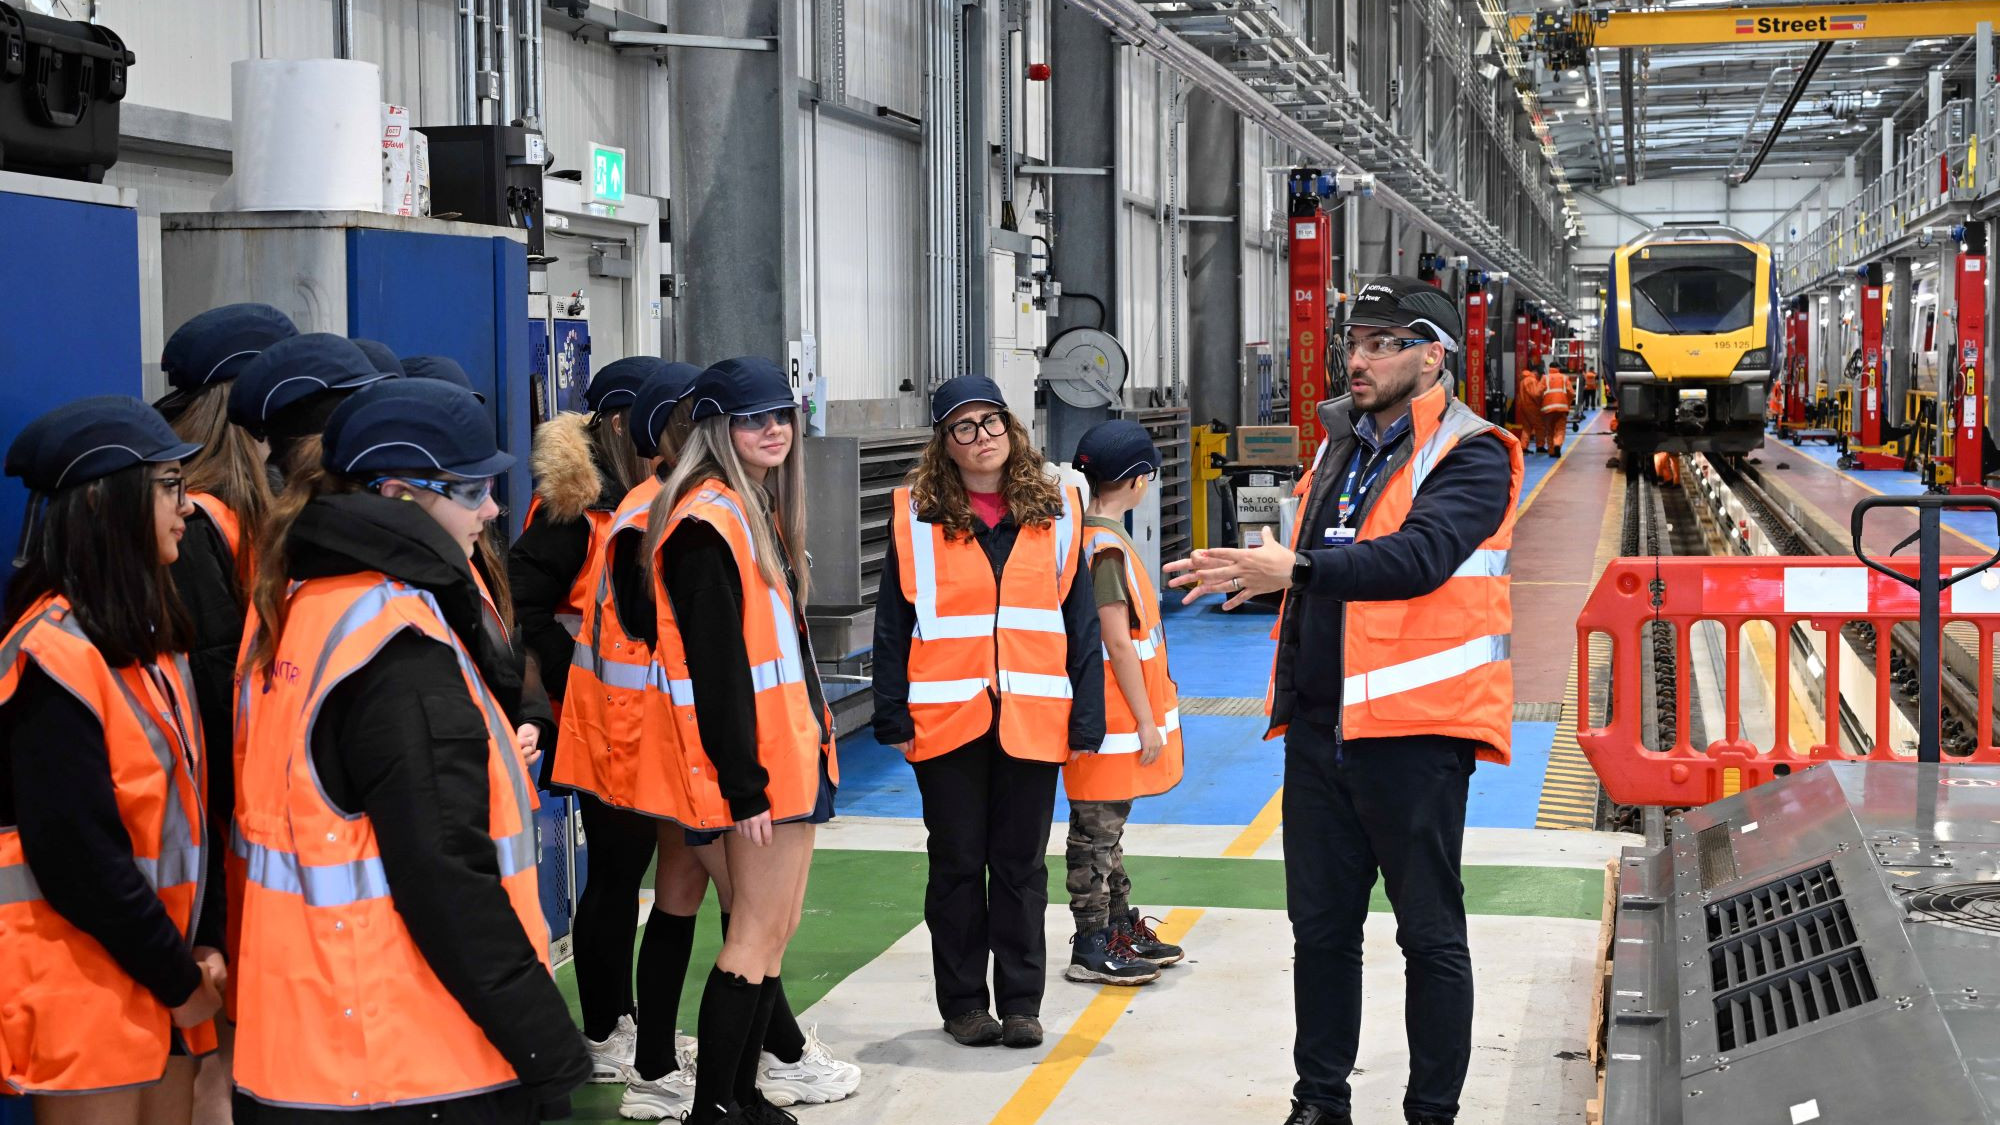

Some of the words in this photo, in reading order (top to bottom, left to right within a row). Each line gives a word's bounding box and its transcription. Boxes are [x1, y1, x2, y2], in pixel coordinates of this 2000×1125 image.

[1758, 16, 1827, 33] Street
[1367, 284, 1394, 294] NORTHERN
[1295, 289, 1313, 301] D4
[1714, 341, 1731, 349] 195
[1734, 341, 1750, 349] 125
[791, 358, 800, 388] R
[1242, 496, 1253, 504] C4
[1257, 496, 1279, 504] TOOL
